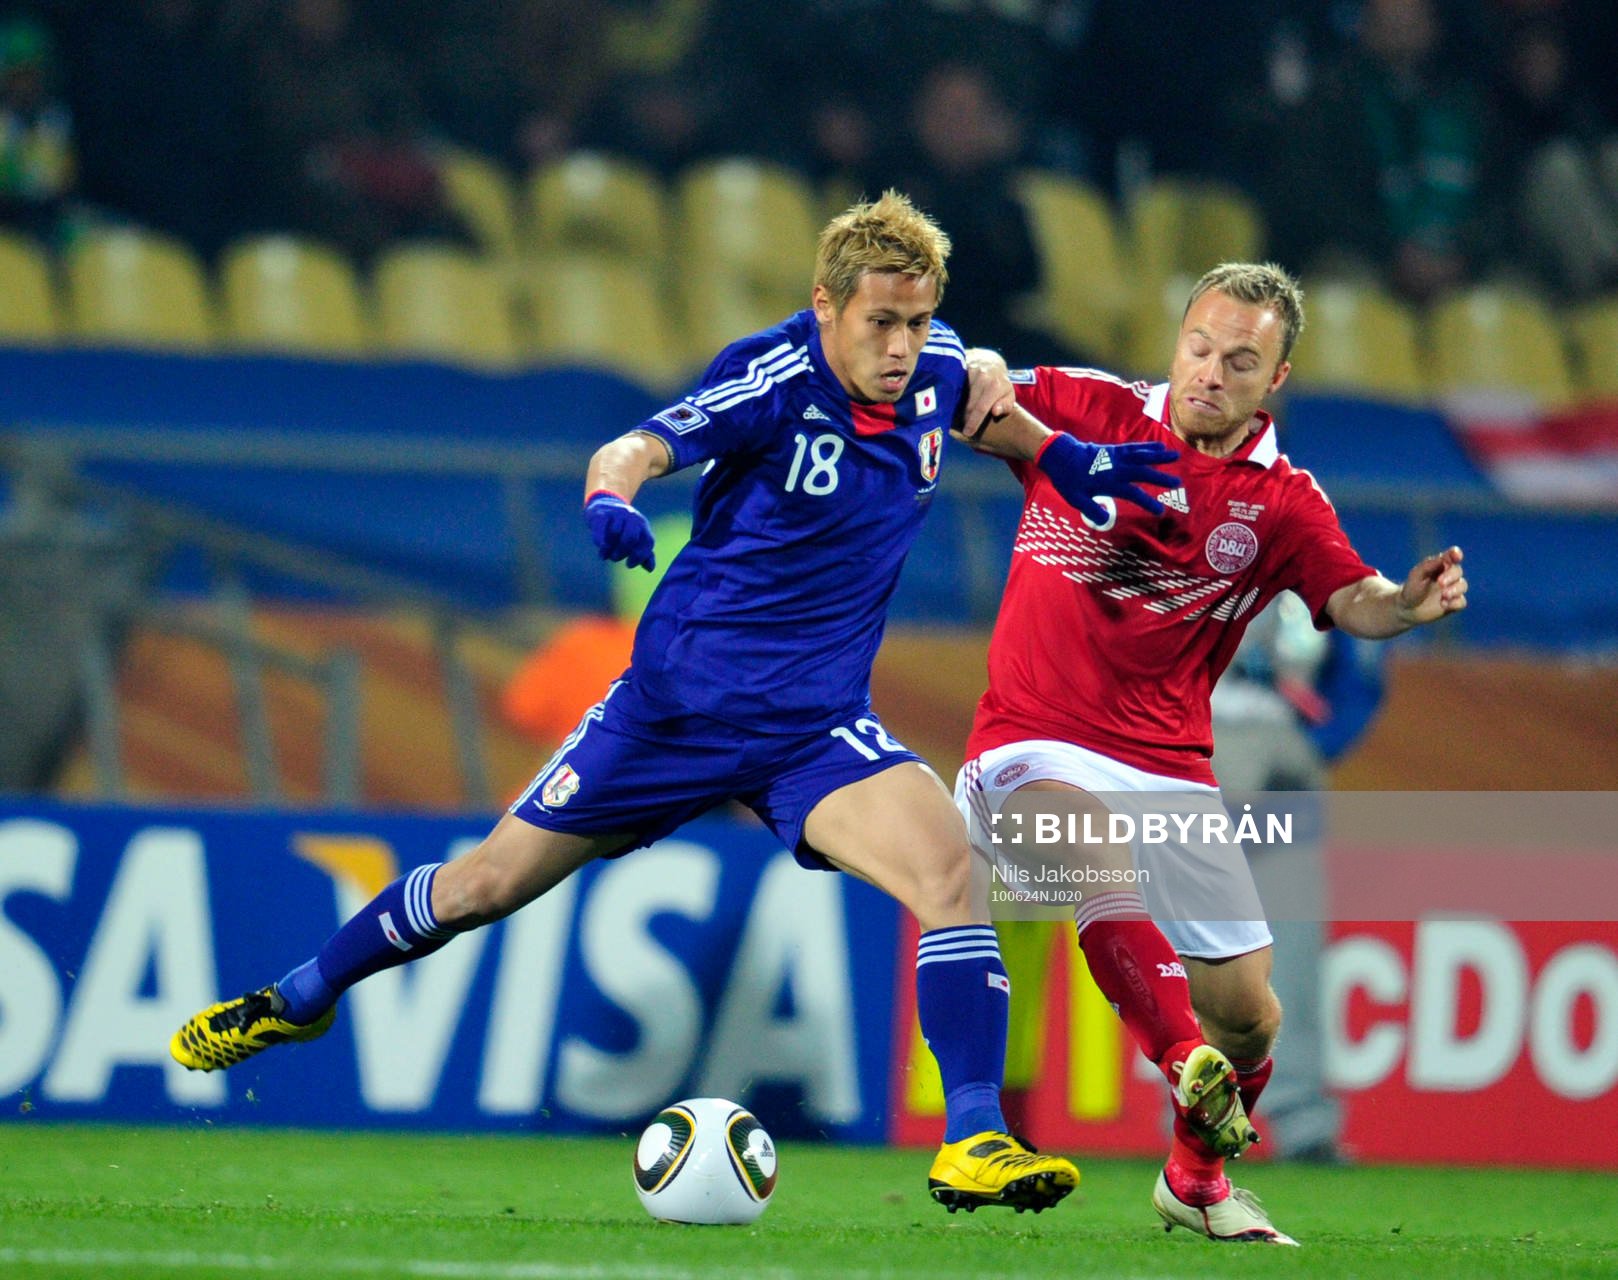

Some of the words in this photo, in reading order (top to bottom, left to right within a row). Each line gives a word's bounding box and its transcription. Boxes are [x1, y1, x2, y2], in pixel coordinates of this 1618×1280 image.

[785, 434, 844, 495] 18
[1157, 493, 1190, 514] adidas
[1217, 538, 1247, 557] DBU
[294, 834, 861, 1121] VISA
